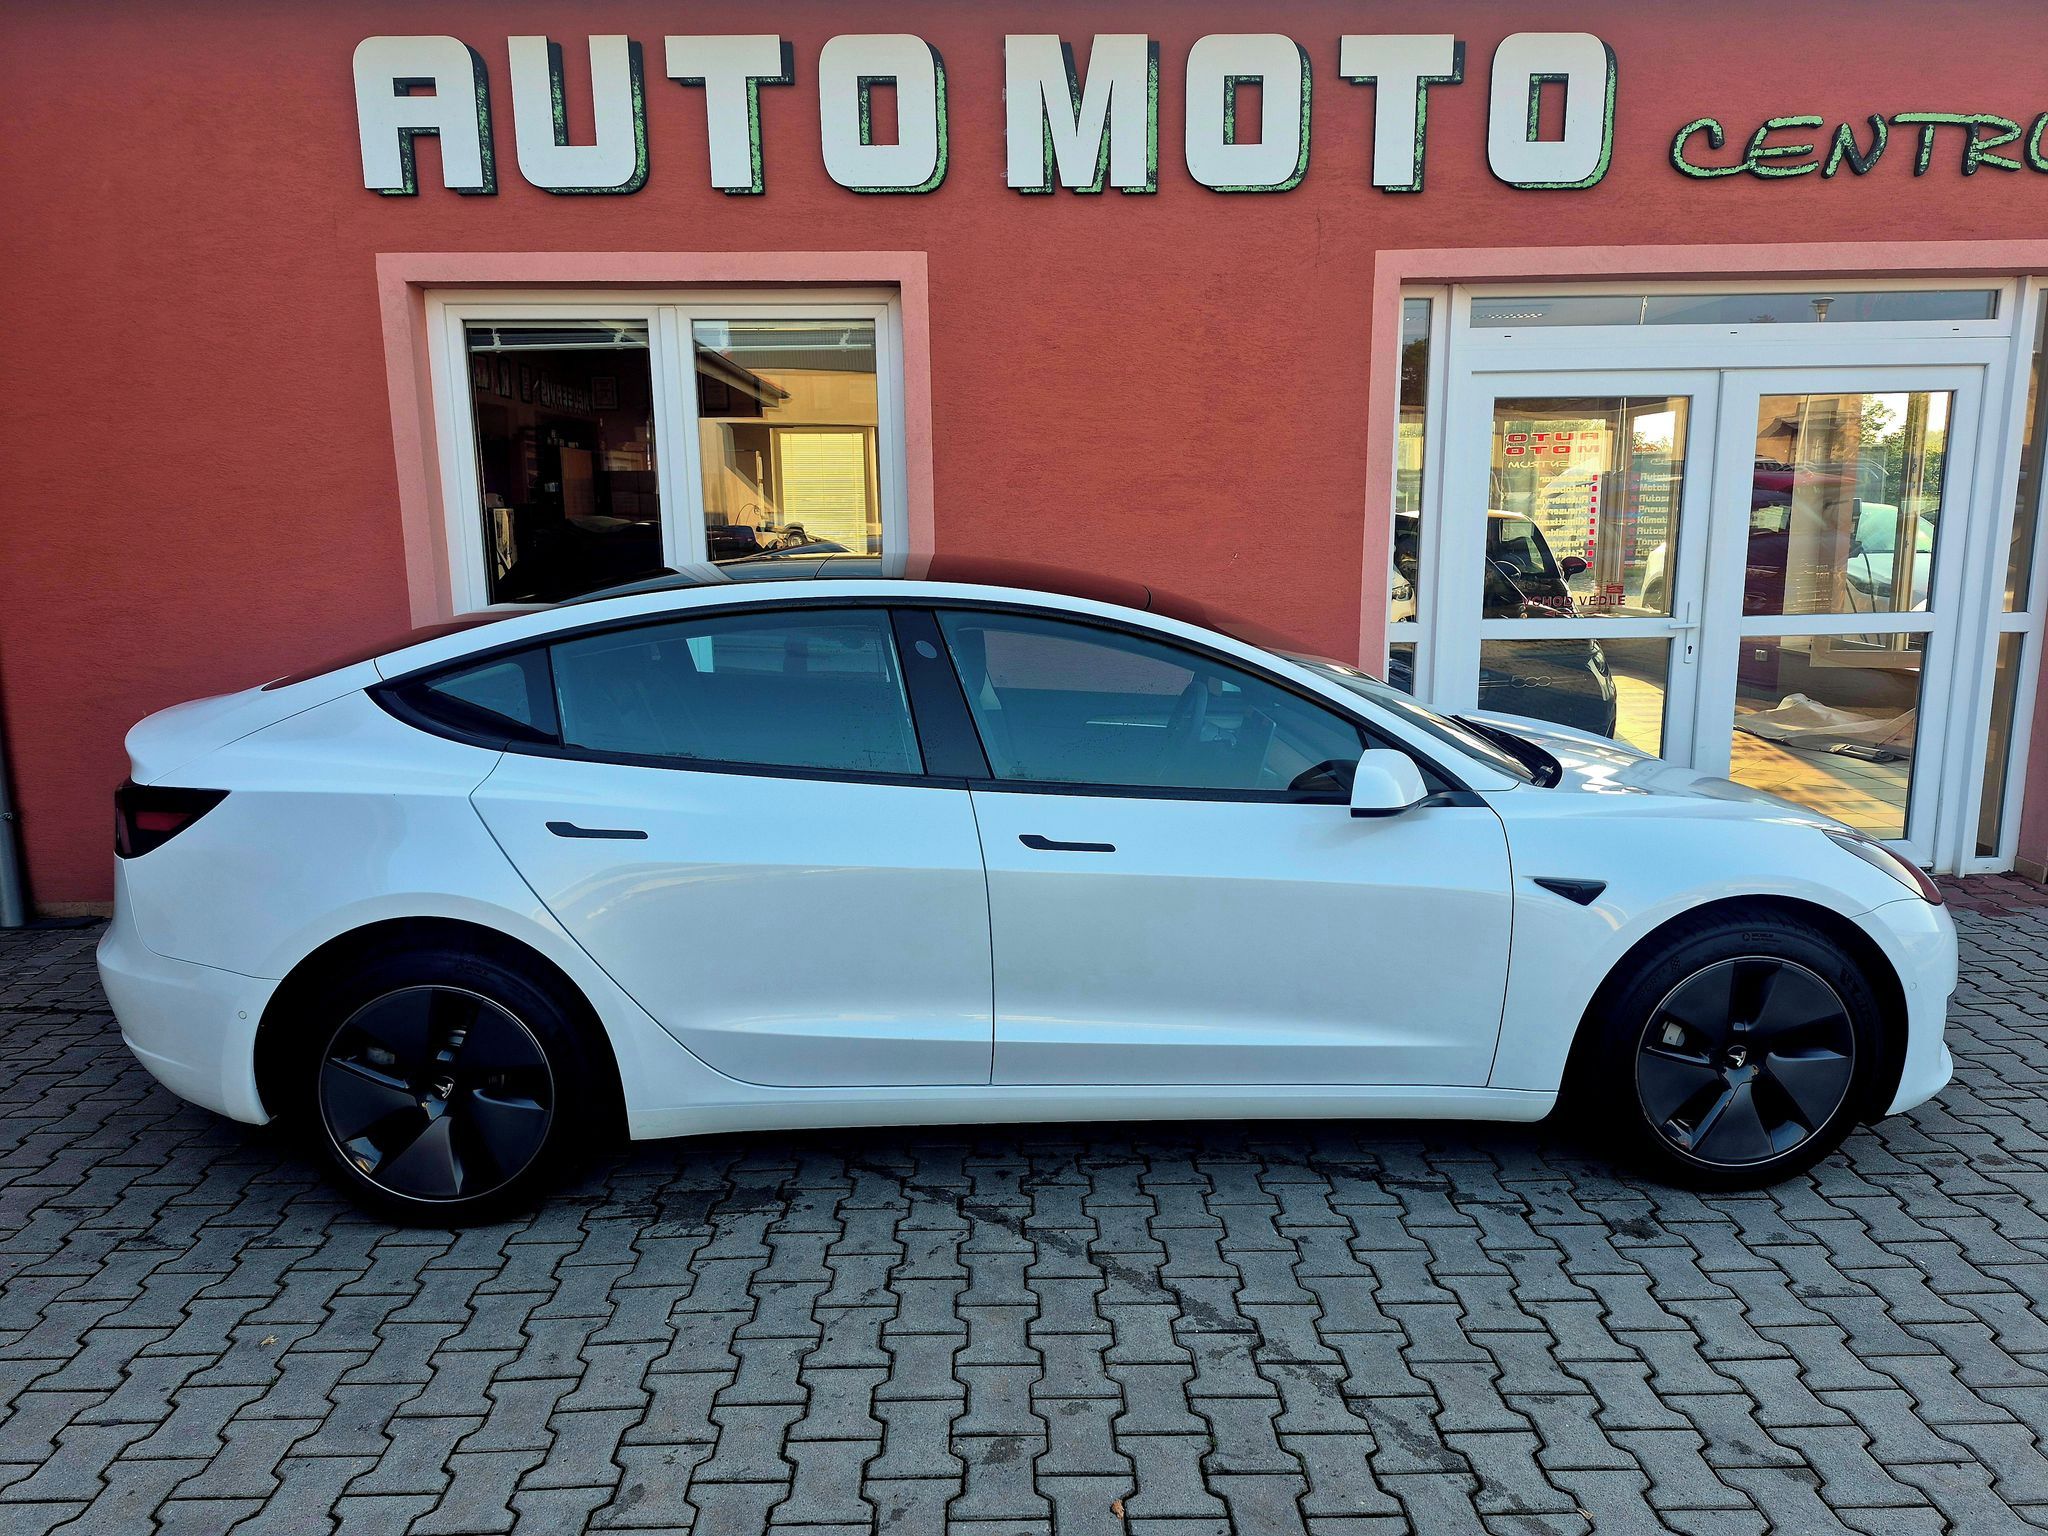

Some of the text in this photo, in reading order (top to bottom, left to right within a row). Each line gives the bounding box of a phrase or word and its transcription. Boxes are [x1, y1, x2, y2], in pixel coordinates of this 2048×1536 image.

[352, 34, 949, 195] AUTO
[1004, 32, 1618, 194] MOTO
[1579, 594, 1626, 606] VEDLE
[1511, 674, 1553, 689] 500
